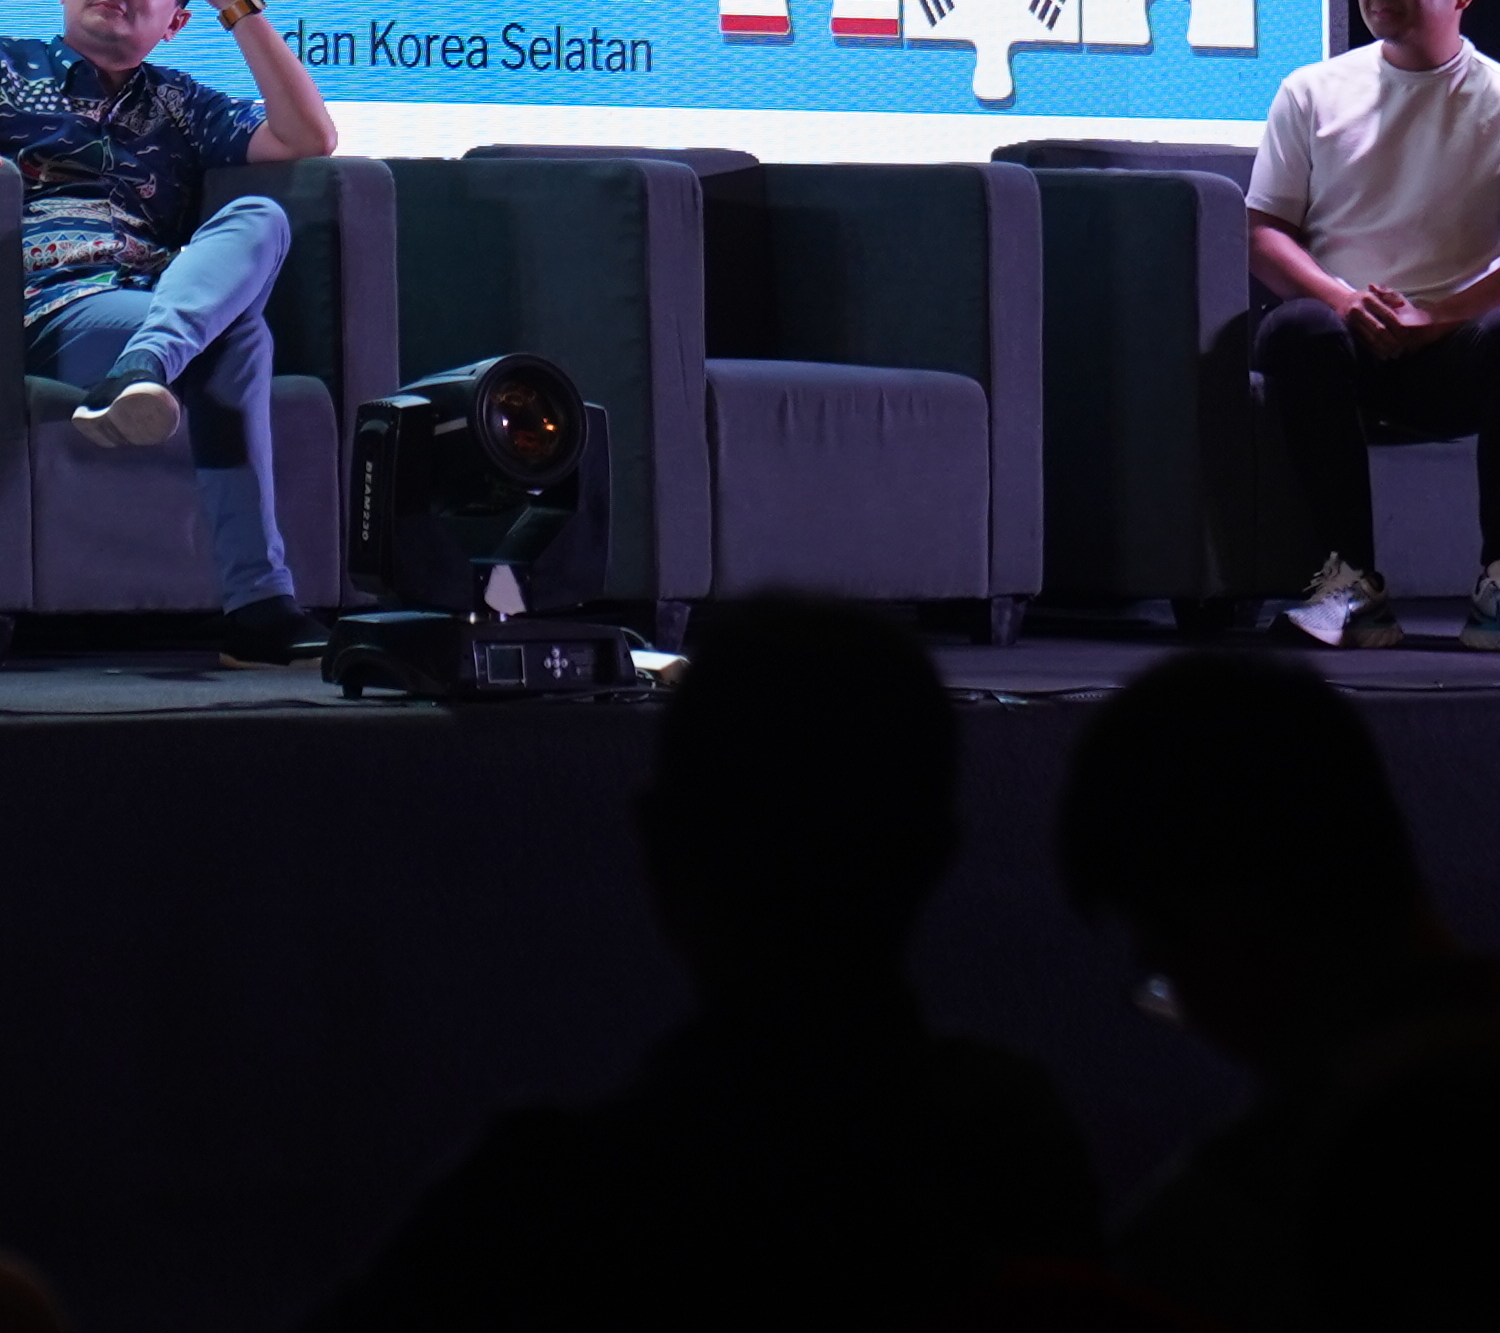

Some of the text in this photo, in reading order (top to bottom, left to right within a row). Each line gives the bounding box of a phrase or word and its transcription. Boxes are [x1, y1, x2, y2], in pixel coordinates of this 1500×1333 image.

[284, 19, 653, 74] dan Korea Selatan
